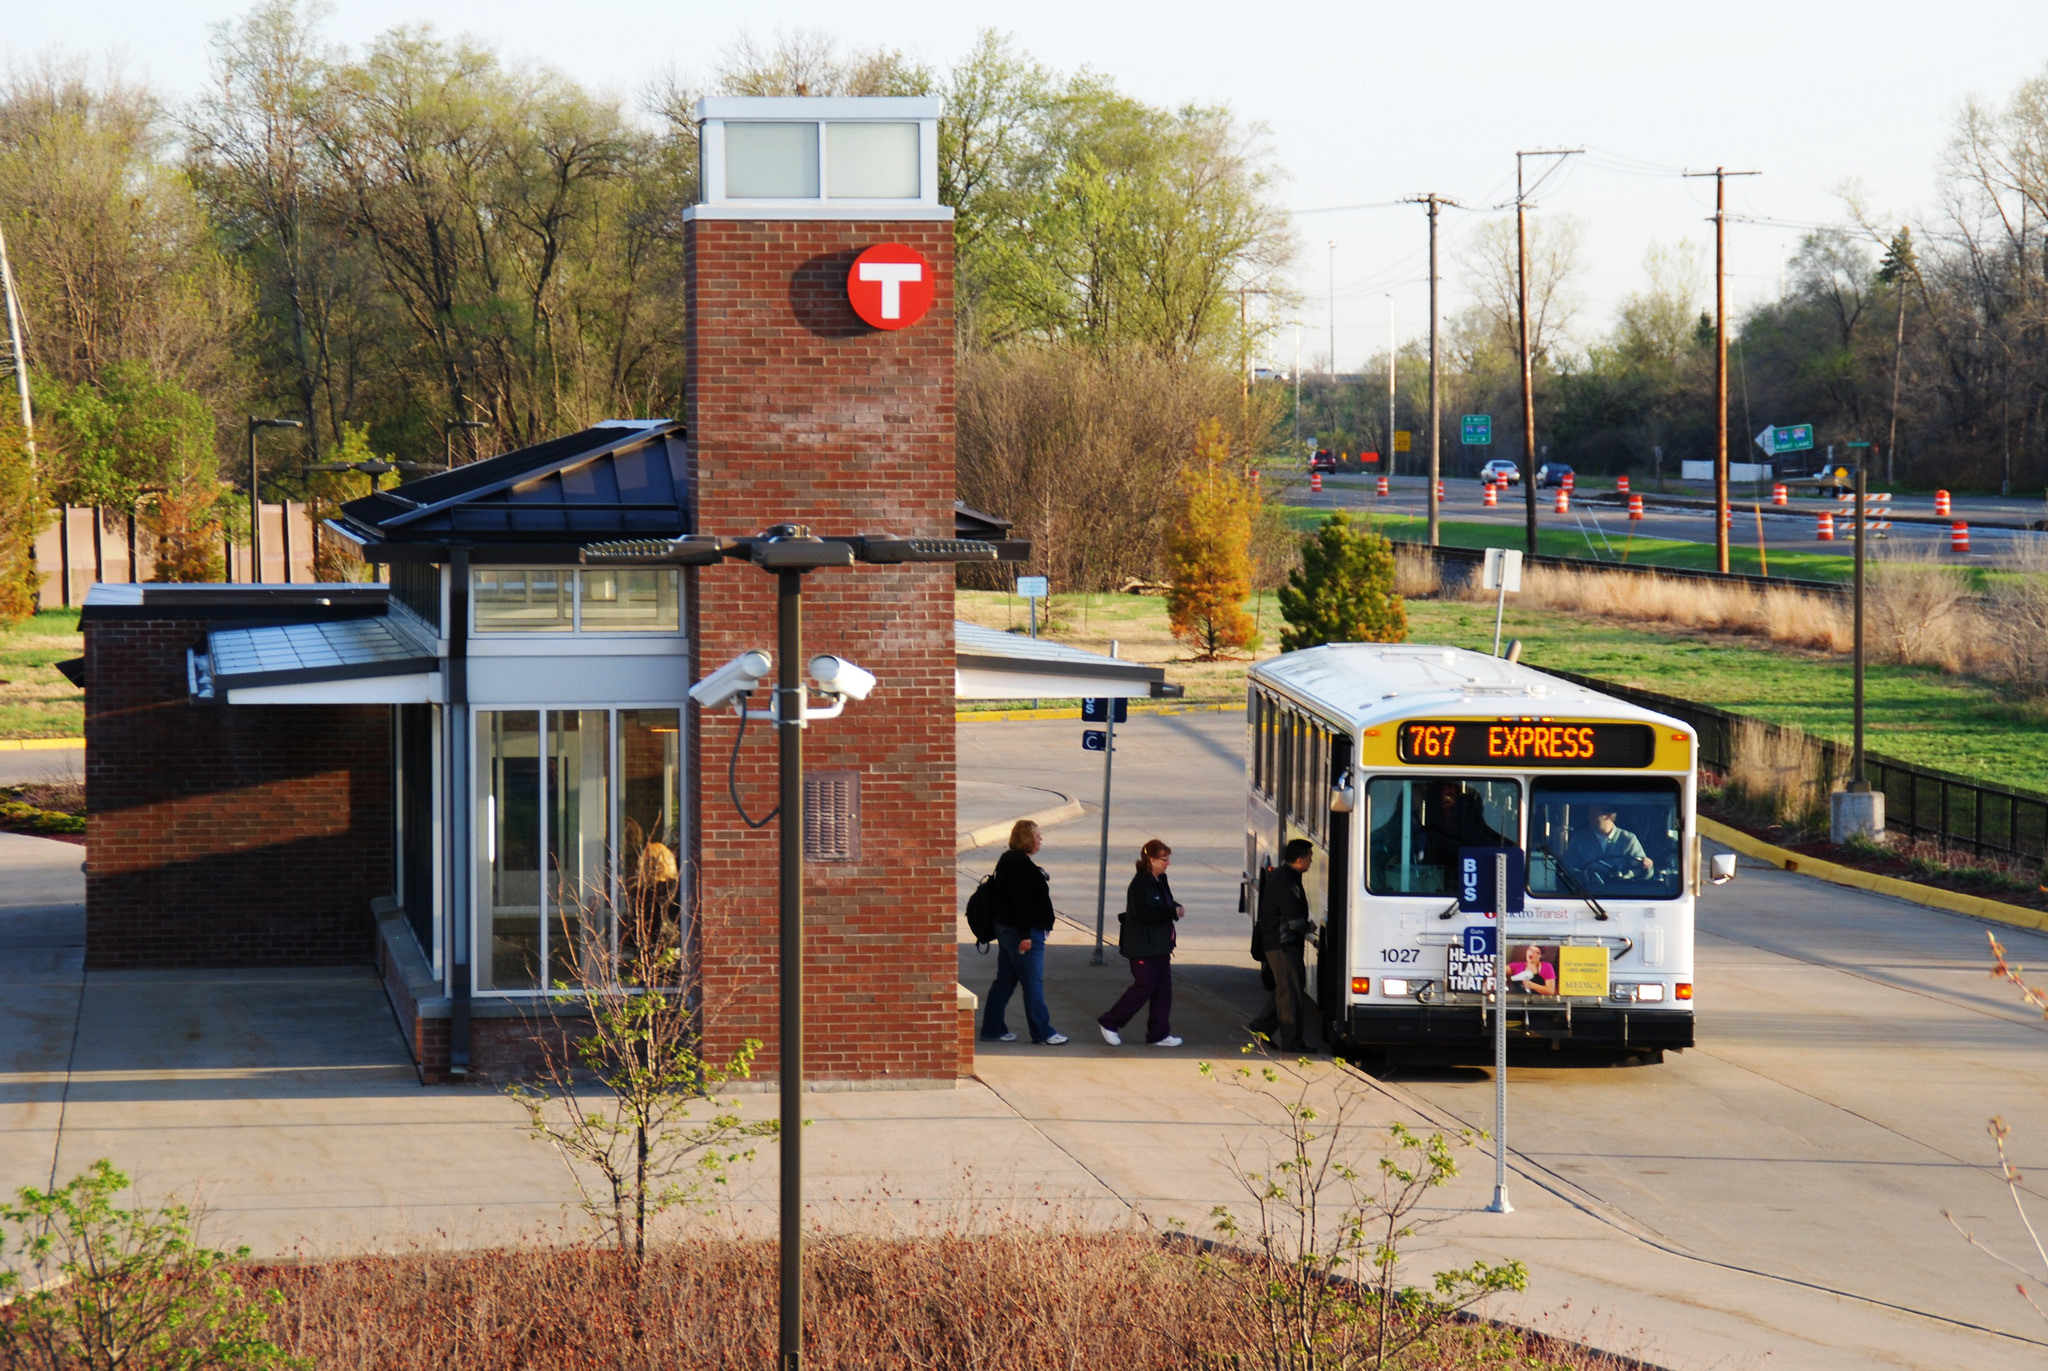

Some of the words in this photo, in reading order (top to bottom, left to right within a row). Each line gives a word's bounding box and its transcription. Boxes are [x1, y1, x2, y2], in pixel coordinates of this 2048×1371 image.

[859, 263, 922, 319] T
[1086, 735, 1098, 749] C
[1410, 726, 1455, 756] 767
[1489, 727, 1594, 758] EXPRESS
[1463, 858, 1477, 902] BUS
[1470, 936, 1486, 954] D
[1380, 948, 1420, 963] 1027
[1449, 962, 1493, 977] PLANS
[1448, 976, 1484, 990] THAT
